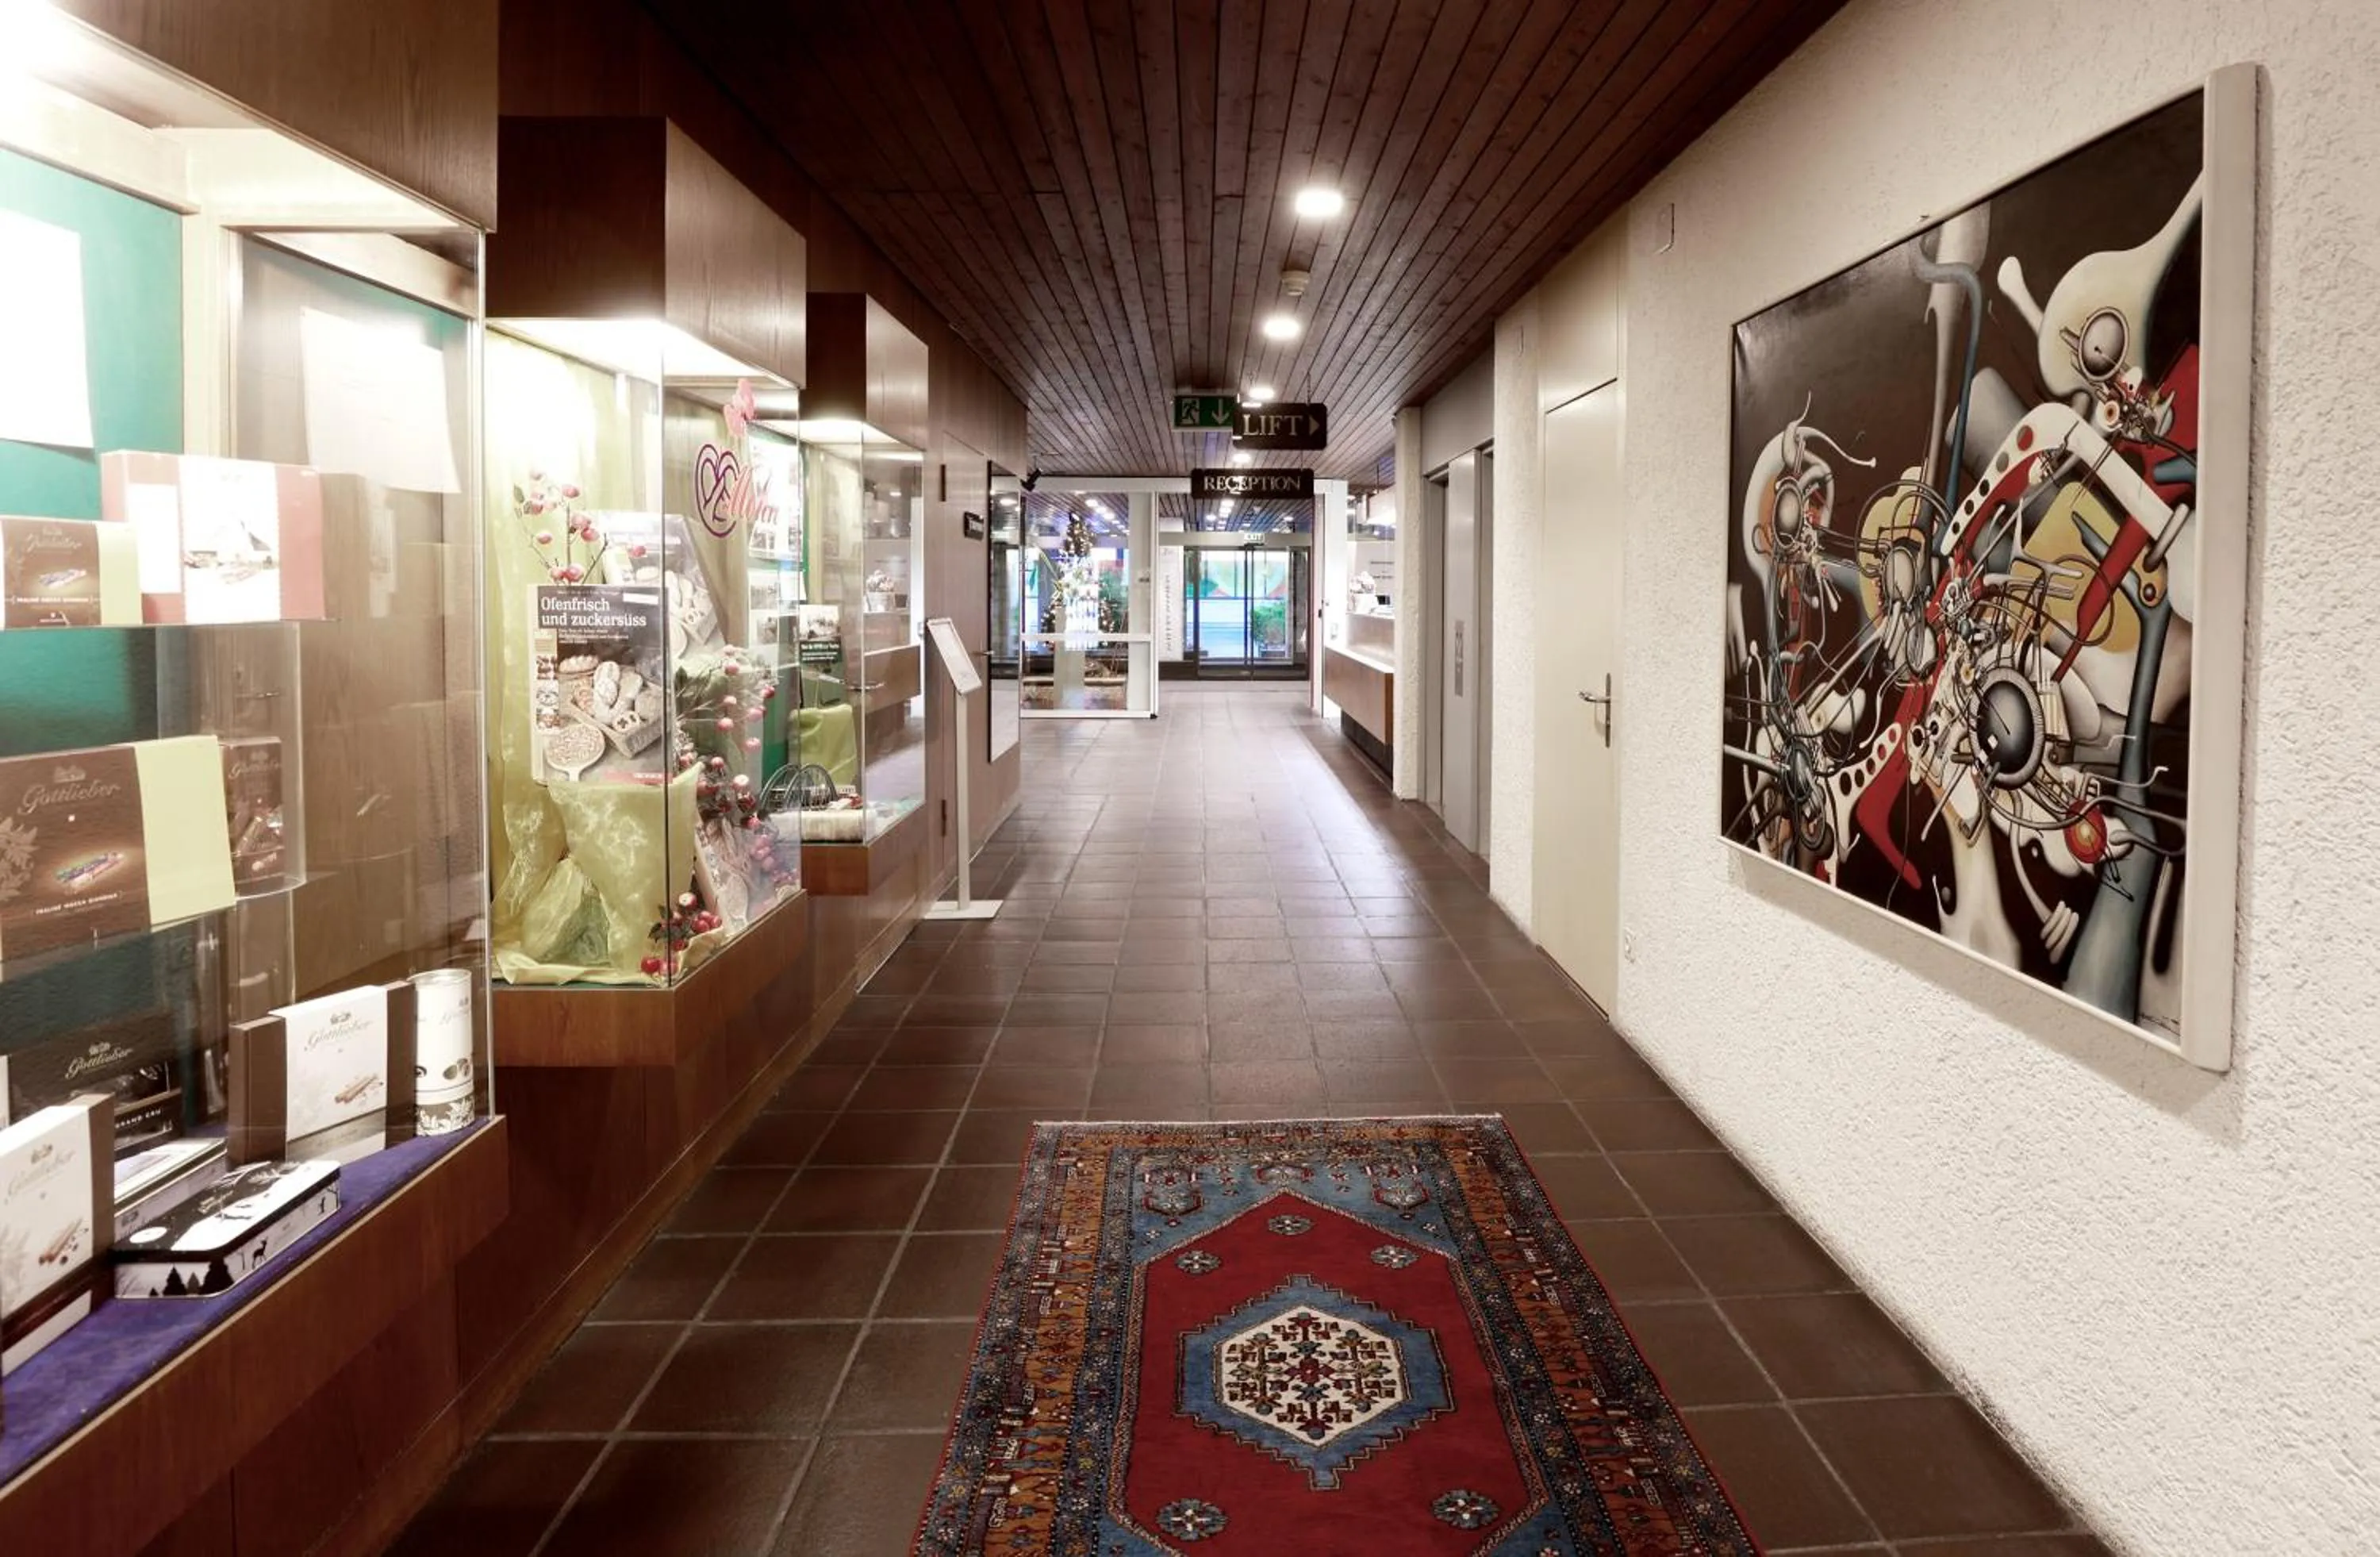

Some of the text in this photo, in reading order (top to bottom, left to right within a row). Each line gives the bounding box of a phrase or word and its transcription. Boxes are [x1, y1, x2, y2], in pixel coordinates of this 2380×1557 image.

[1242, 413, 1303, 436] LIFT
[1203, 475, 1301, 491] RECEPTION
[541, 596, 610, 611] Ofenfrisch
[542, 613, 647, 626] und zuckersüss
[17, 778, 121, 814] Gottlieber
